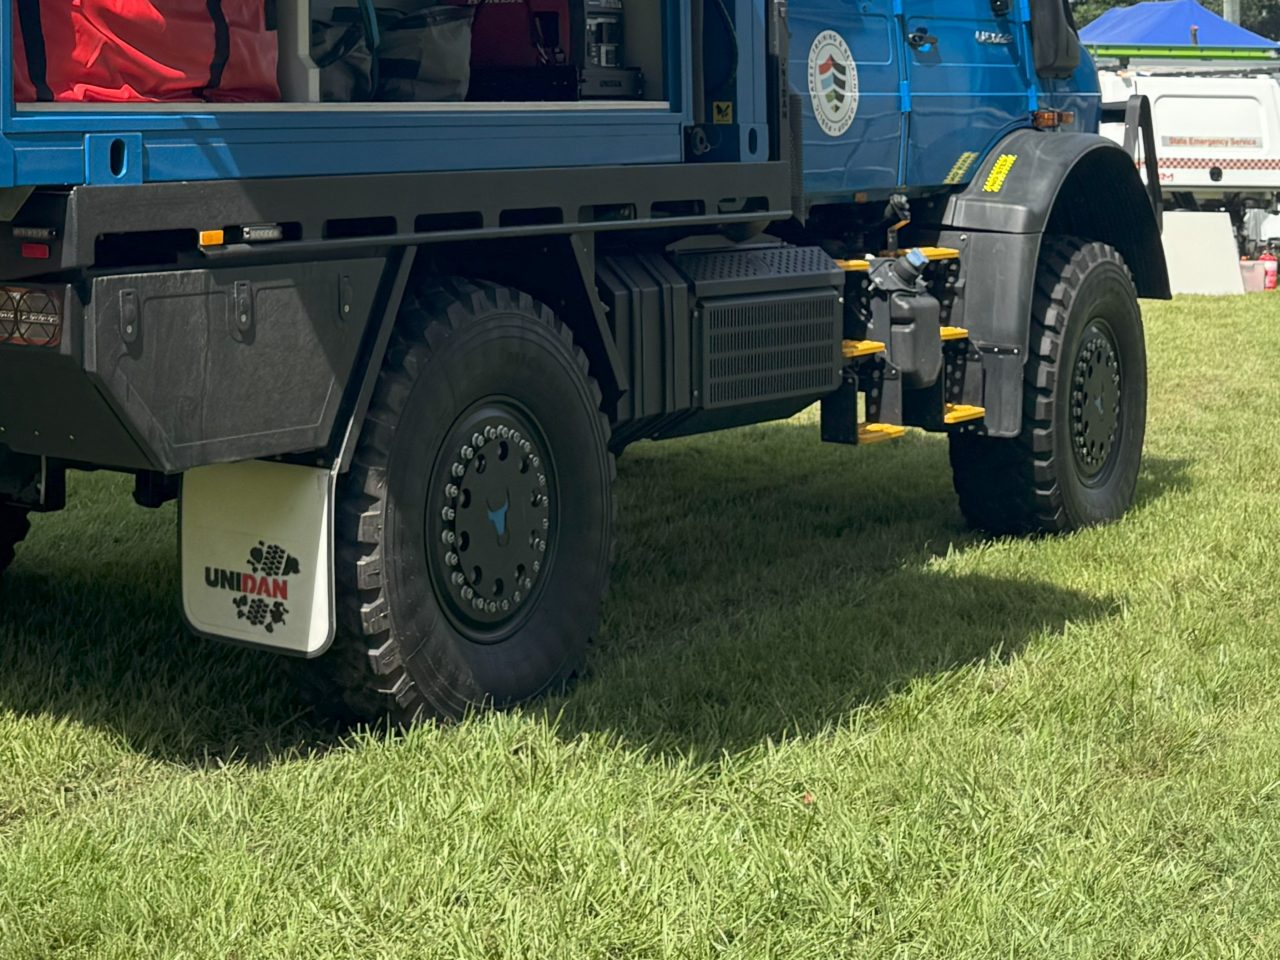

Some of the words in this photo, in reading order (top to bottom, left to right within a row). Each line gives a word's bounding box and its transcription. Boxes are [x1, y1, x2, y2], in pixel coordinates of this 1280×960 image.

[1169, 136, 1187, 145] State
[1189, 137, 1228, 147] Emergency
[1230, 137, 1257, 146] Service
[205, 566, 288, 601] UNIDAN
